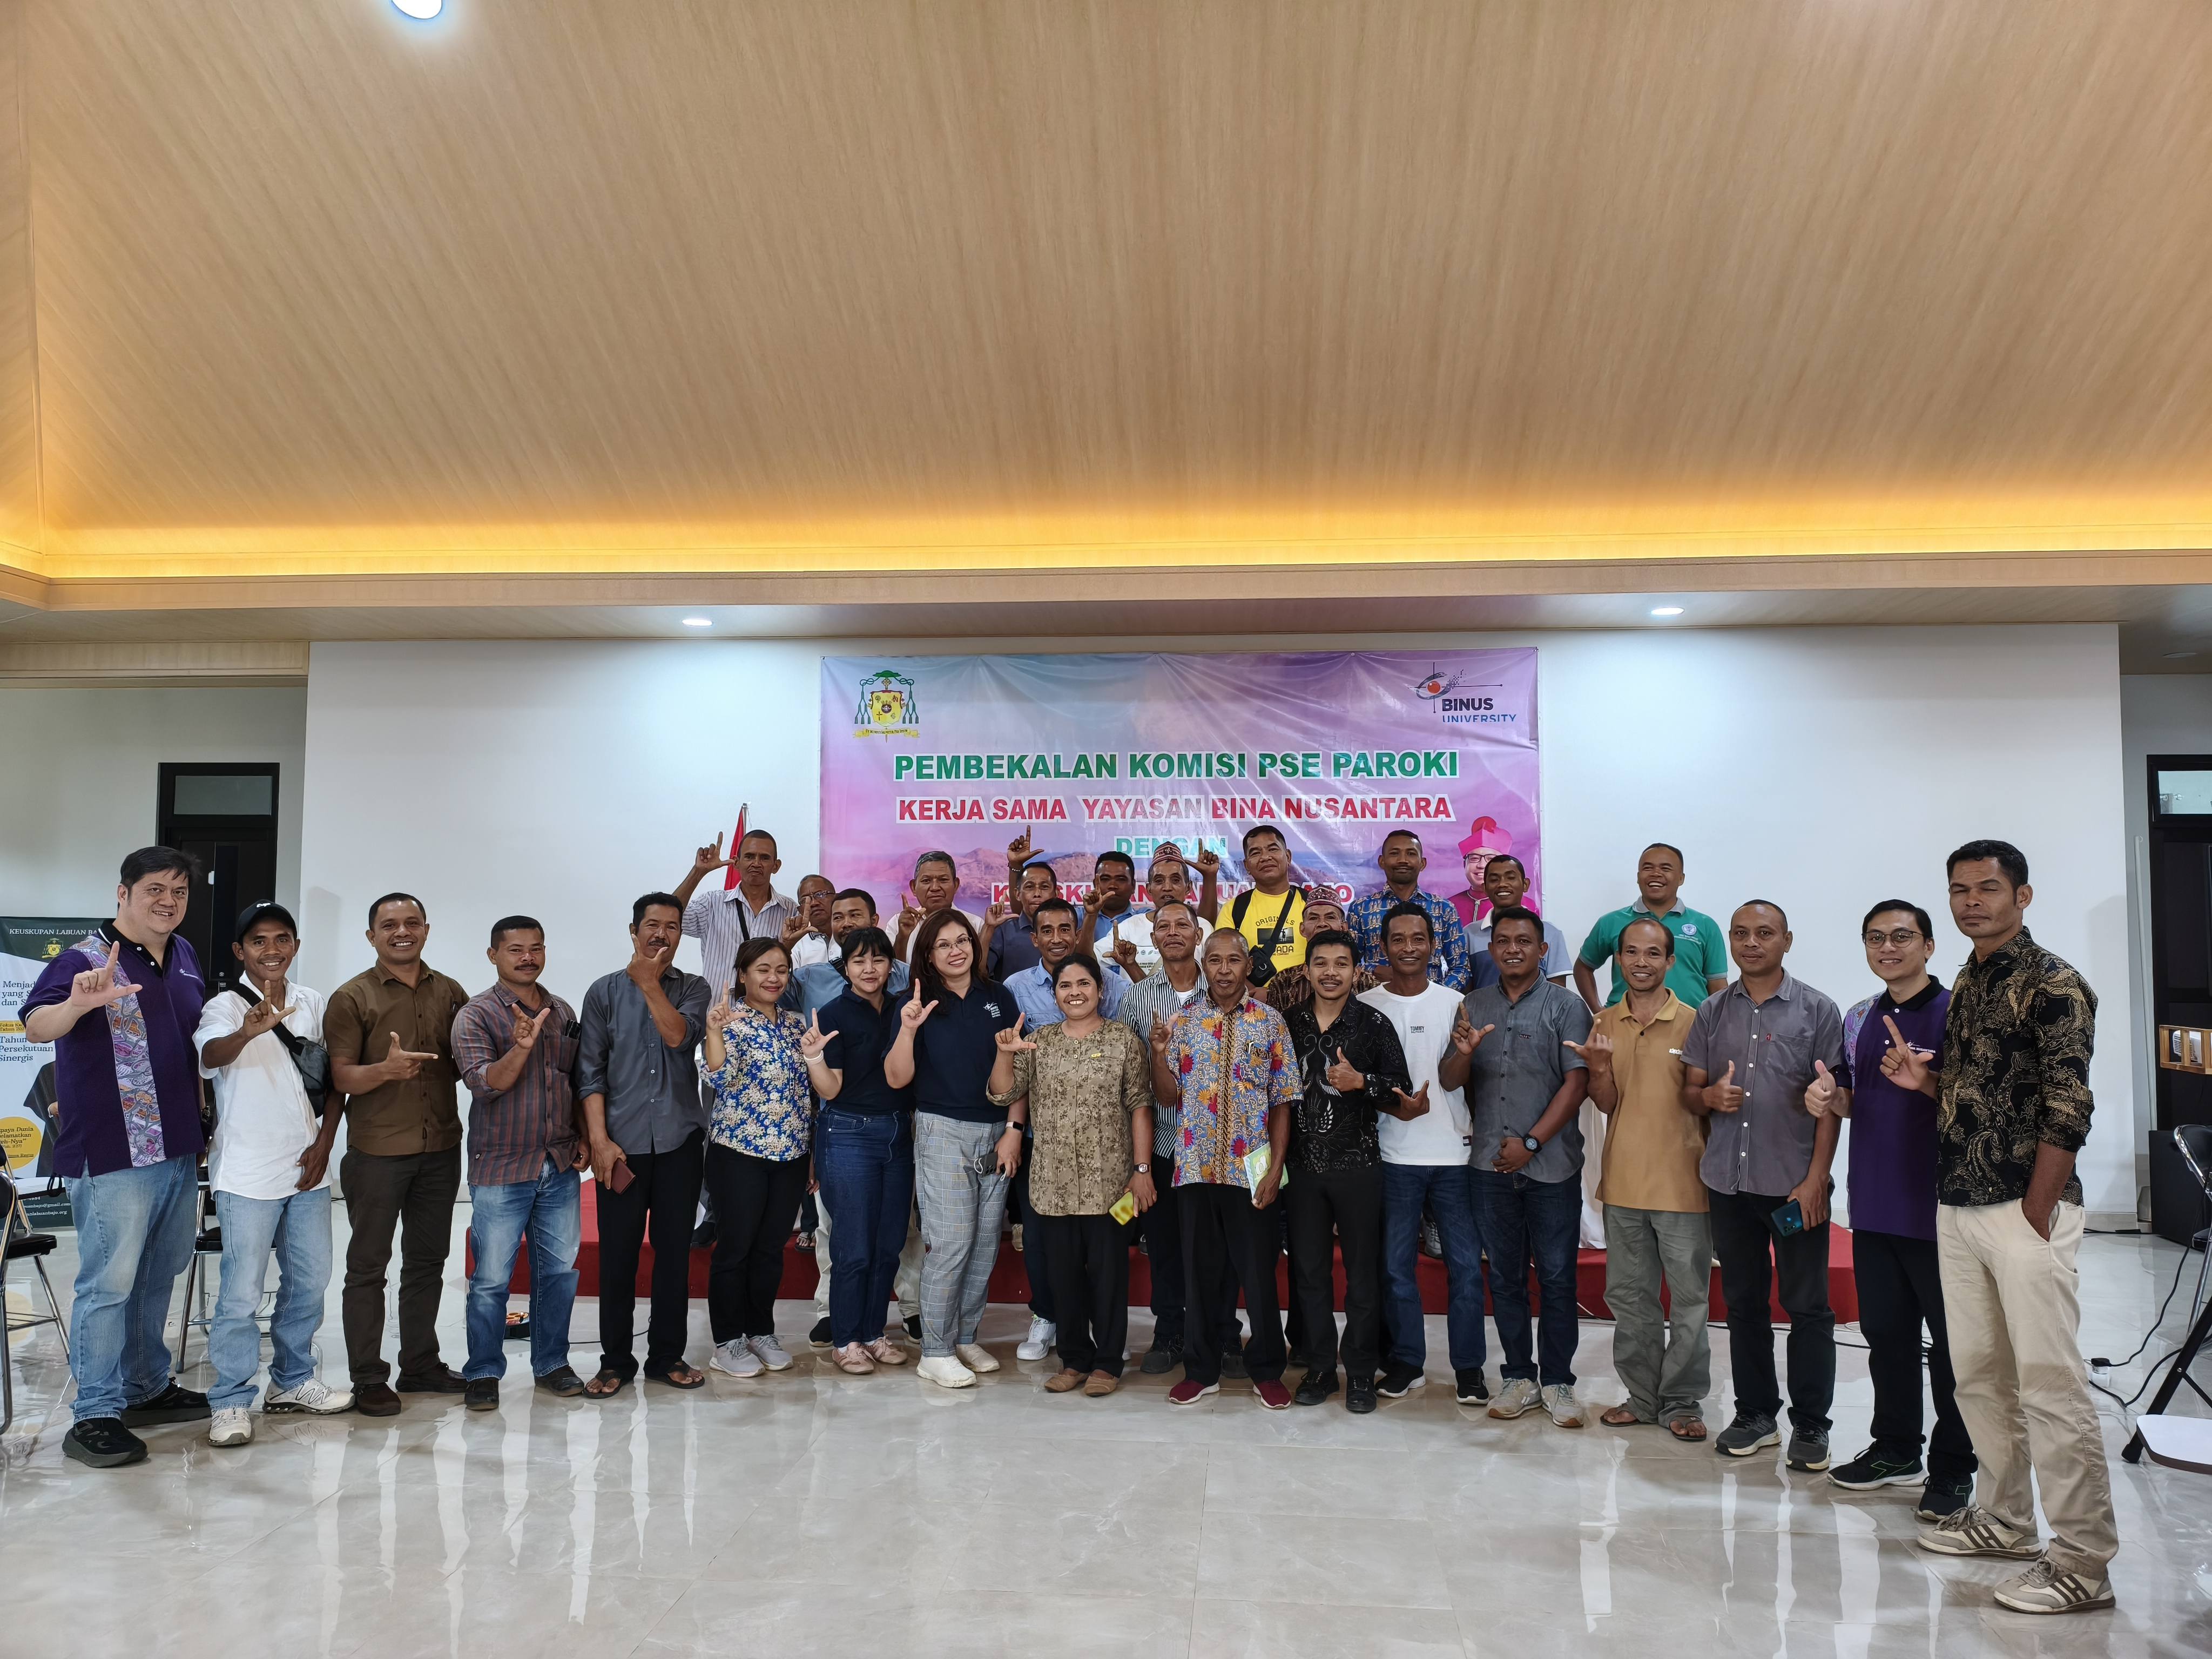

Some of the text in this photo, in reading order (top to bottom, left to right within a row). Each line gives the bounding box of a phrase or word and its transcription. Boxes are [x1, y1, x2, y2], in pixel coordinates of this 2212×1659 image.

[1442, 698, 1494, 711] BINUS
[1442, 714, 1516, 723] UNIVERSITY
[895, 752, 1458, 779] PEMBEKALAN KOMISI PSE PAROKI
[899, 797, 1452, 820] KERJA SAMA YAYASAN BINA NUSANTARA
[3, 981, 36, 989] Menjad
